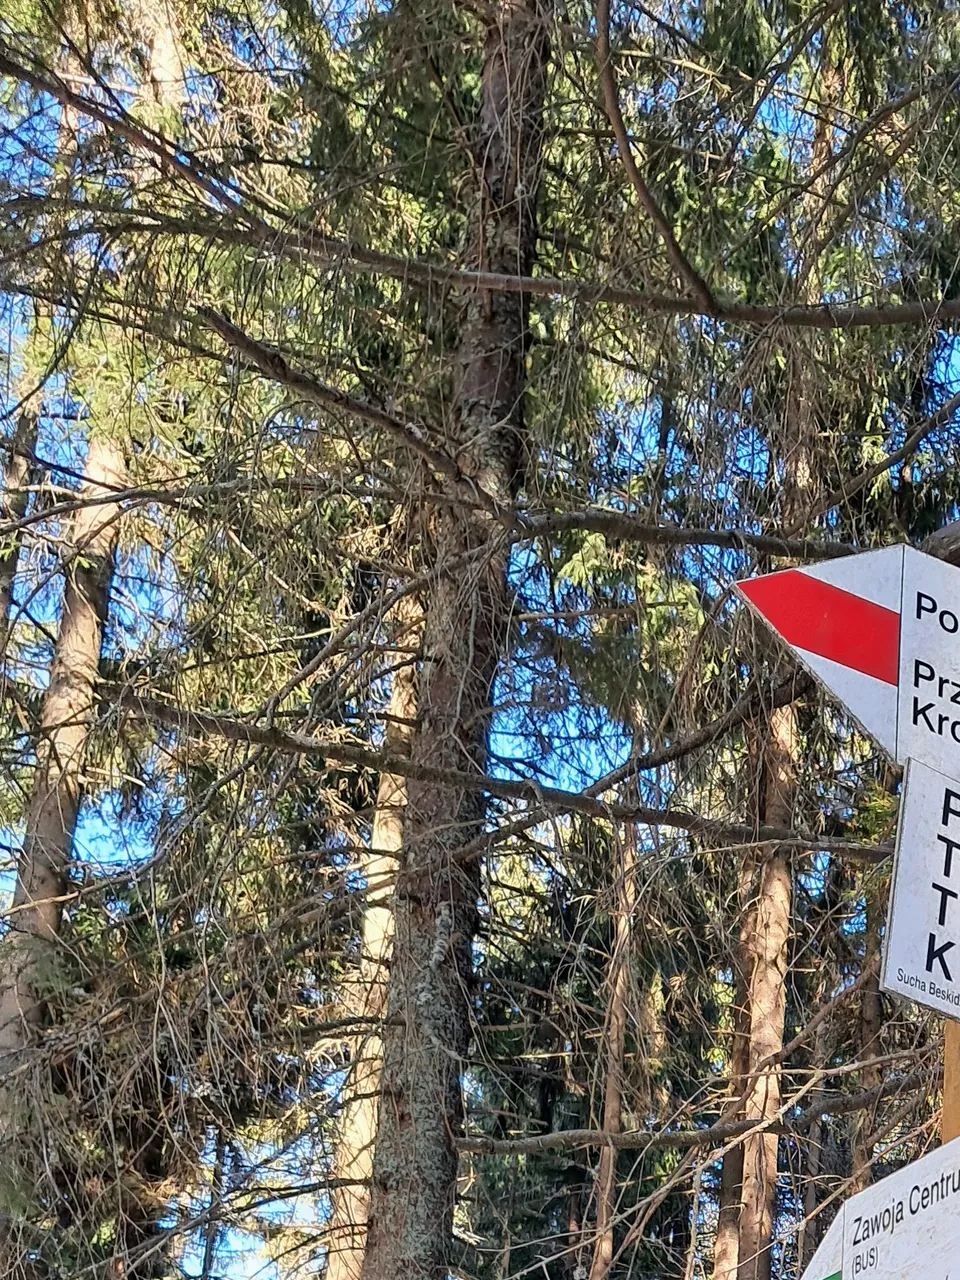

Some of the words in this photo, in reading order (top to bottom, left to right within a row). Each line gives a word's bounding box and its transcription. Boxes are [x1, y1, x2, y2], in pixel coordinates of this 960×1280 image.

[897, 968, 926, 992] Sucha
[852, 1198, 904, 1247] Zawoja
[851, 1246, 879, 1280] (BUS)
